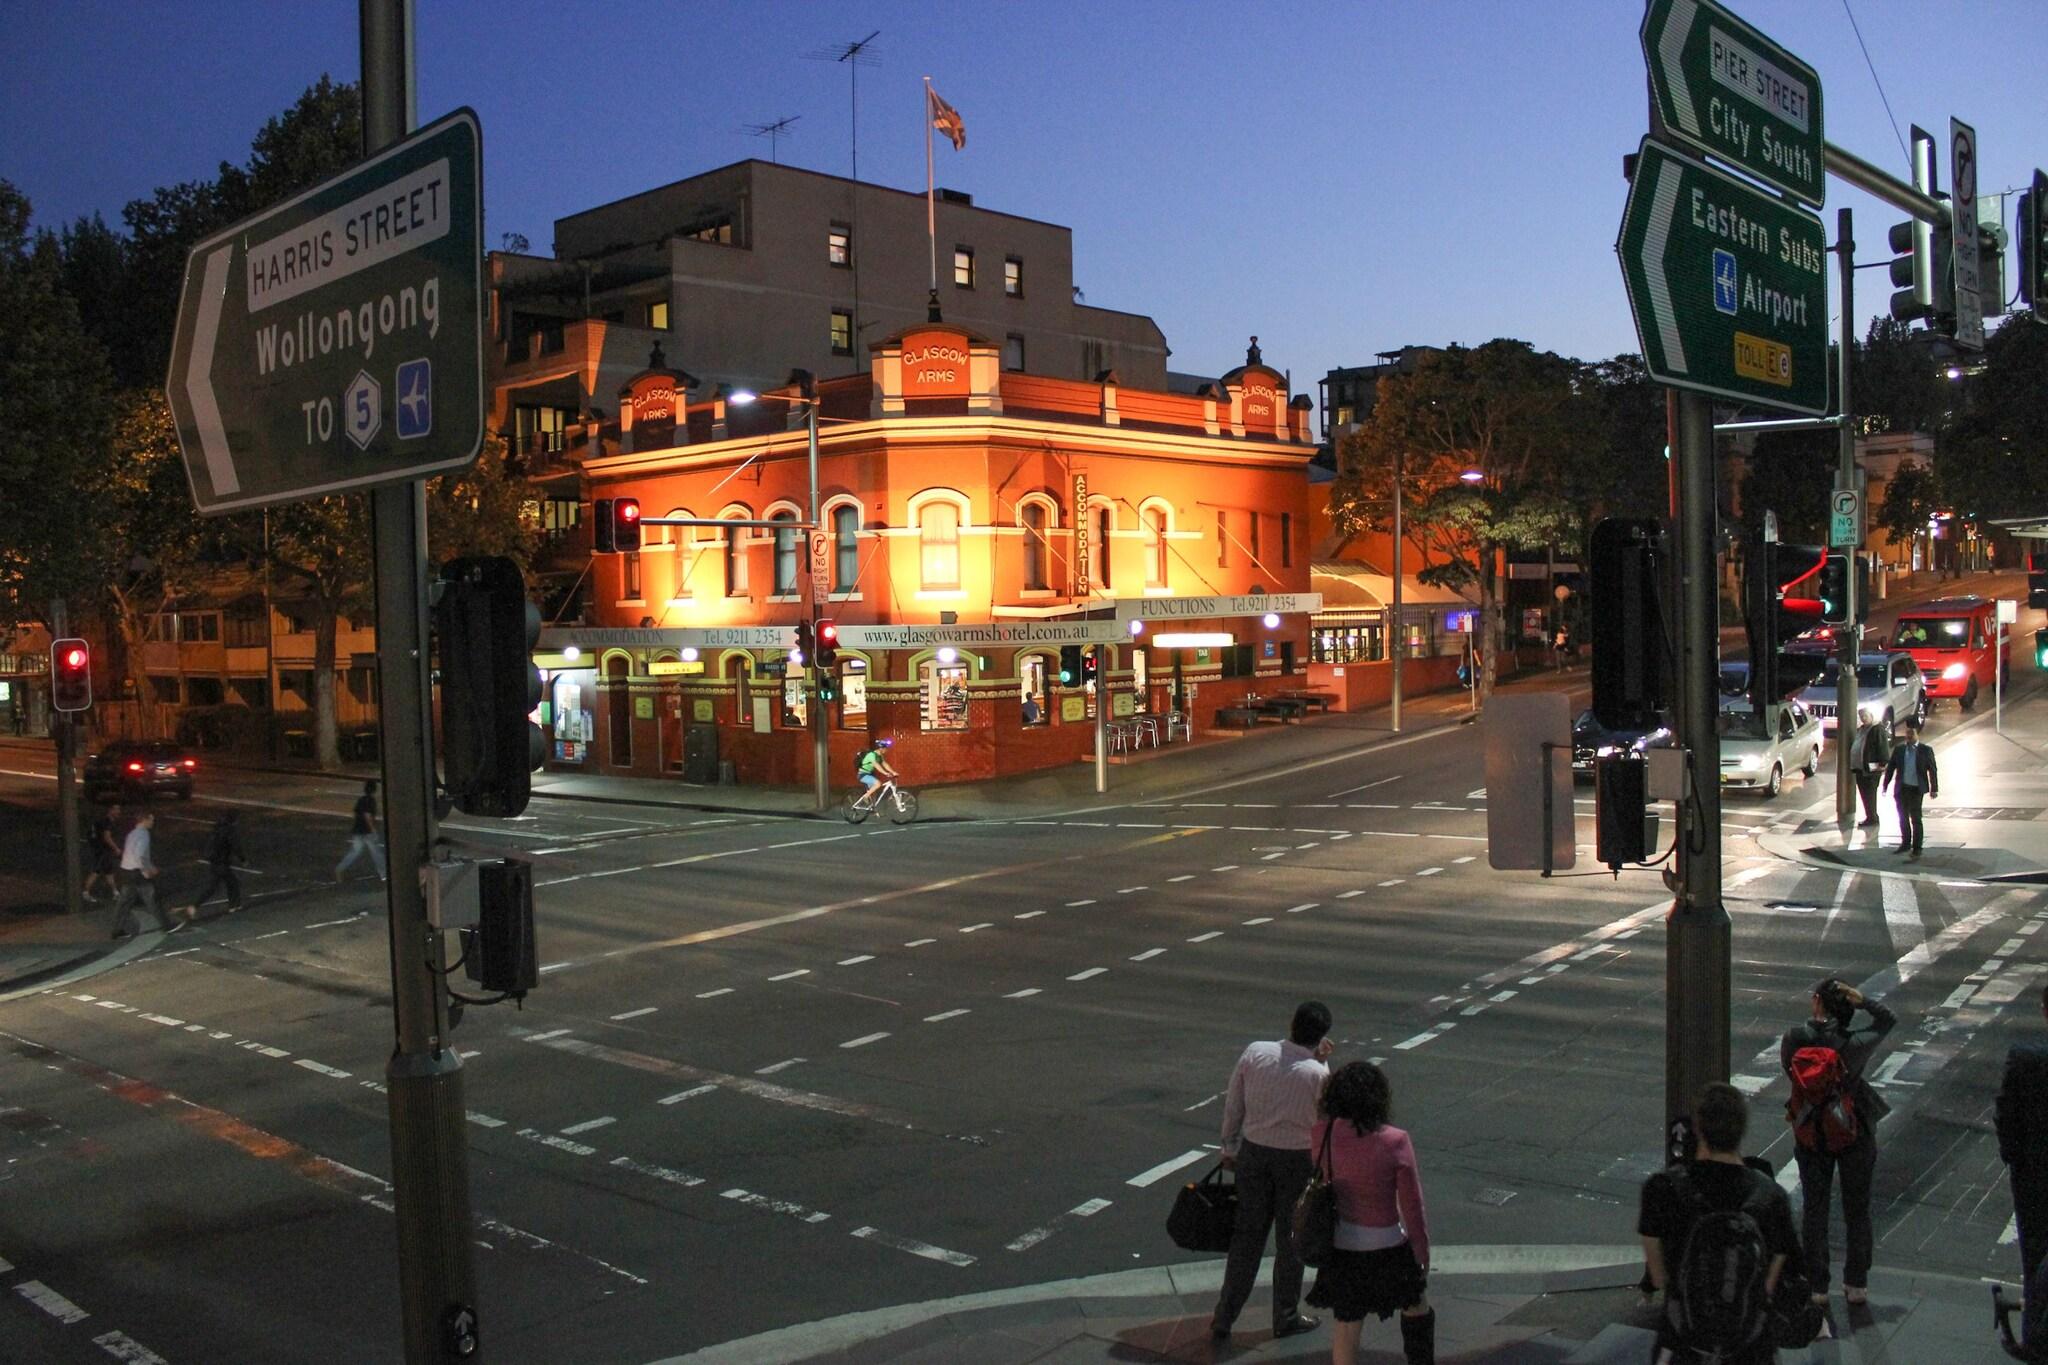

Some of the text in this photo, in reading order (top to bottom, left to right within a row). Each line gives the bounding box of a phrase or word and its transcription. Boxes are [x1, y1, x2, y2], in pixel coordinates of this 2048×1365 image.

[1714, 41, 1805, 120] PIER STREET
[1710, 97, 1812, 183] City South
[253, 179, 441, 295] HARRIS STREET
[1692, 187, 1820, 274] Eastern Subs
[1743, 272, 1808, 327] Airport
[256, 277, 440, 376] Wollongong
[903, 346, 968, 366] GLASGOW
[1737, 342, 1766, 369] TOLL
[916, 369, 956, 384] ARMS
[634, 389, 677, 409] GLASGOW
[1241, 384, 1276, 403] GLASGOW
[302, 388, 371, 445] TO 5
[643, 408, 668, 422] ARMS
[1247, 403, 1270, 416] ARMS
[1838, 517, 1853, 526] NO
[1076, 475, 1088, 593] ACCOMMODATION
[815, 557, 826, 567] NO
[1141, 600, 1215, 615] FUNCTIONS
[1274, 596, 1296, 609] 2354
[704, 630, 724, 644] Tel.
[727, 629, 749, 644] 9211
[755, 629, 782, 643] 2354
